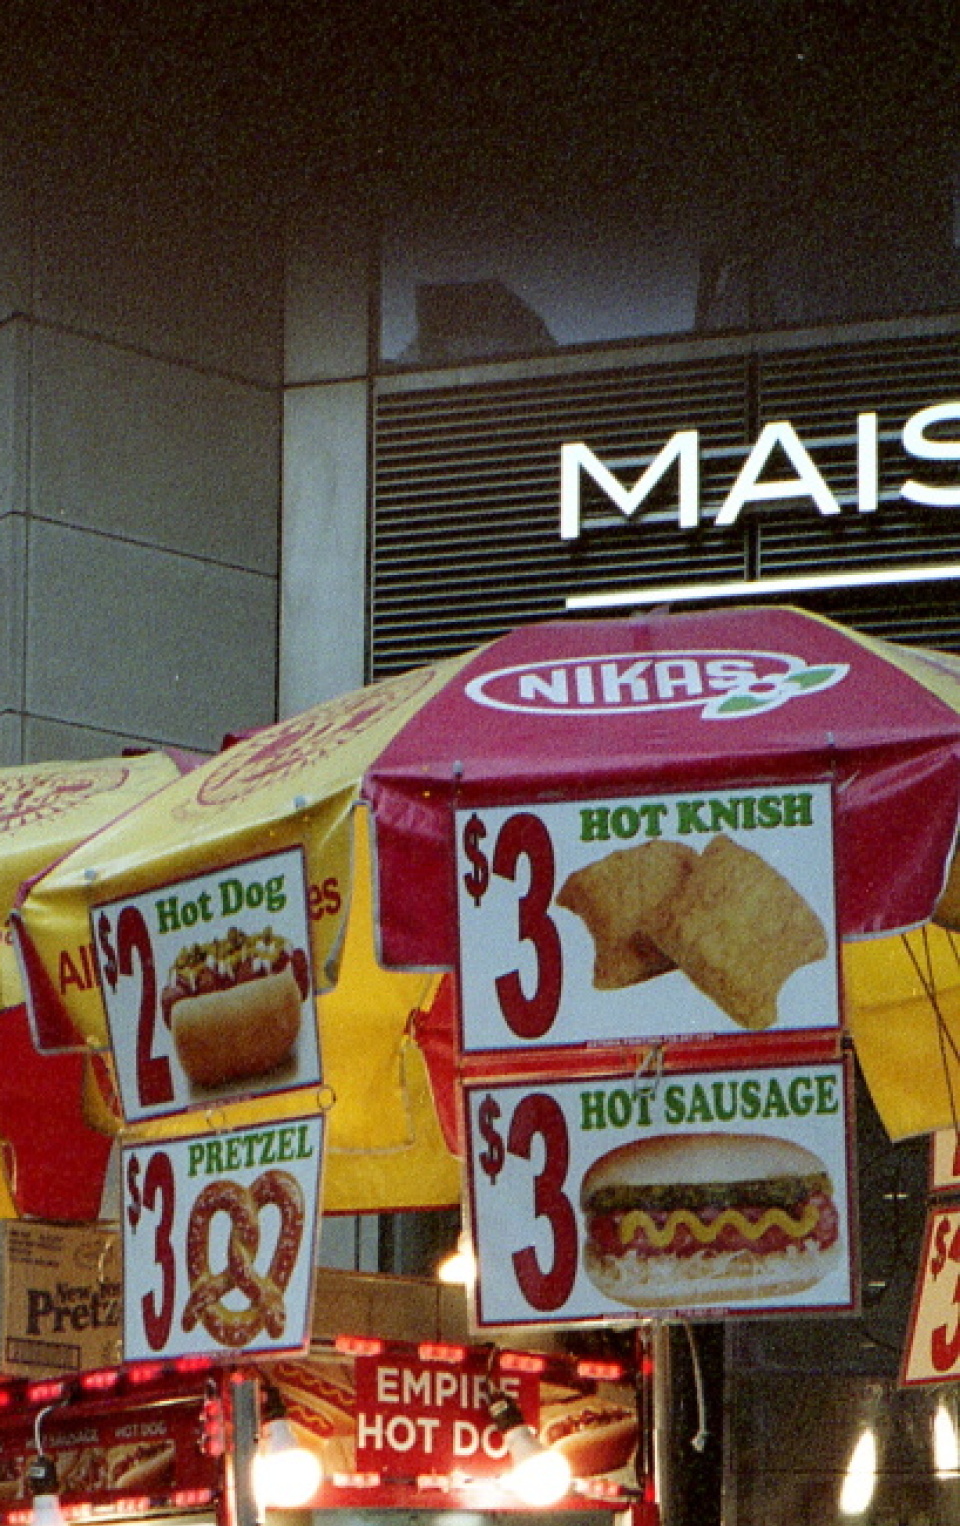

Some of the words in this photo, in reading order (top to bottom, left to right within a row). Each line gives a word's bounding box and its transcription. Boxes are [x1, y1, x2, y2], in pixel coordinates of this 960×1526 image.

[518, 658, 756, 704] NIKAS
[578, 804, 669, 842] HOT
[676, 793, 815, 836] KNISH
[154, 890, 215, 935] Hot
[218, 873, 287, 917] Dog
[579, 1089, 655, 1131] HOT
[663, 1074, 840, 1125] SAUSAGE
[187, 1123, 316, 1178] PRETZEL
[25, 1288, 122, 1335] Pretz
[357, 1412, 442, 1456] HOT
[452, 1419, 538, 1459] DO
